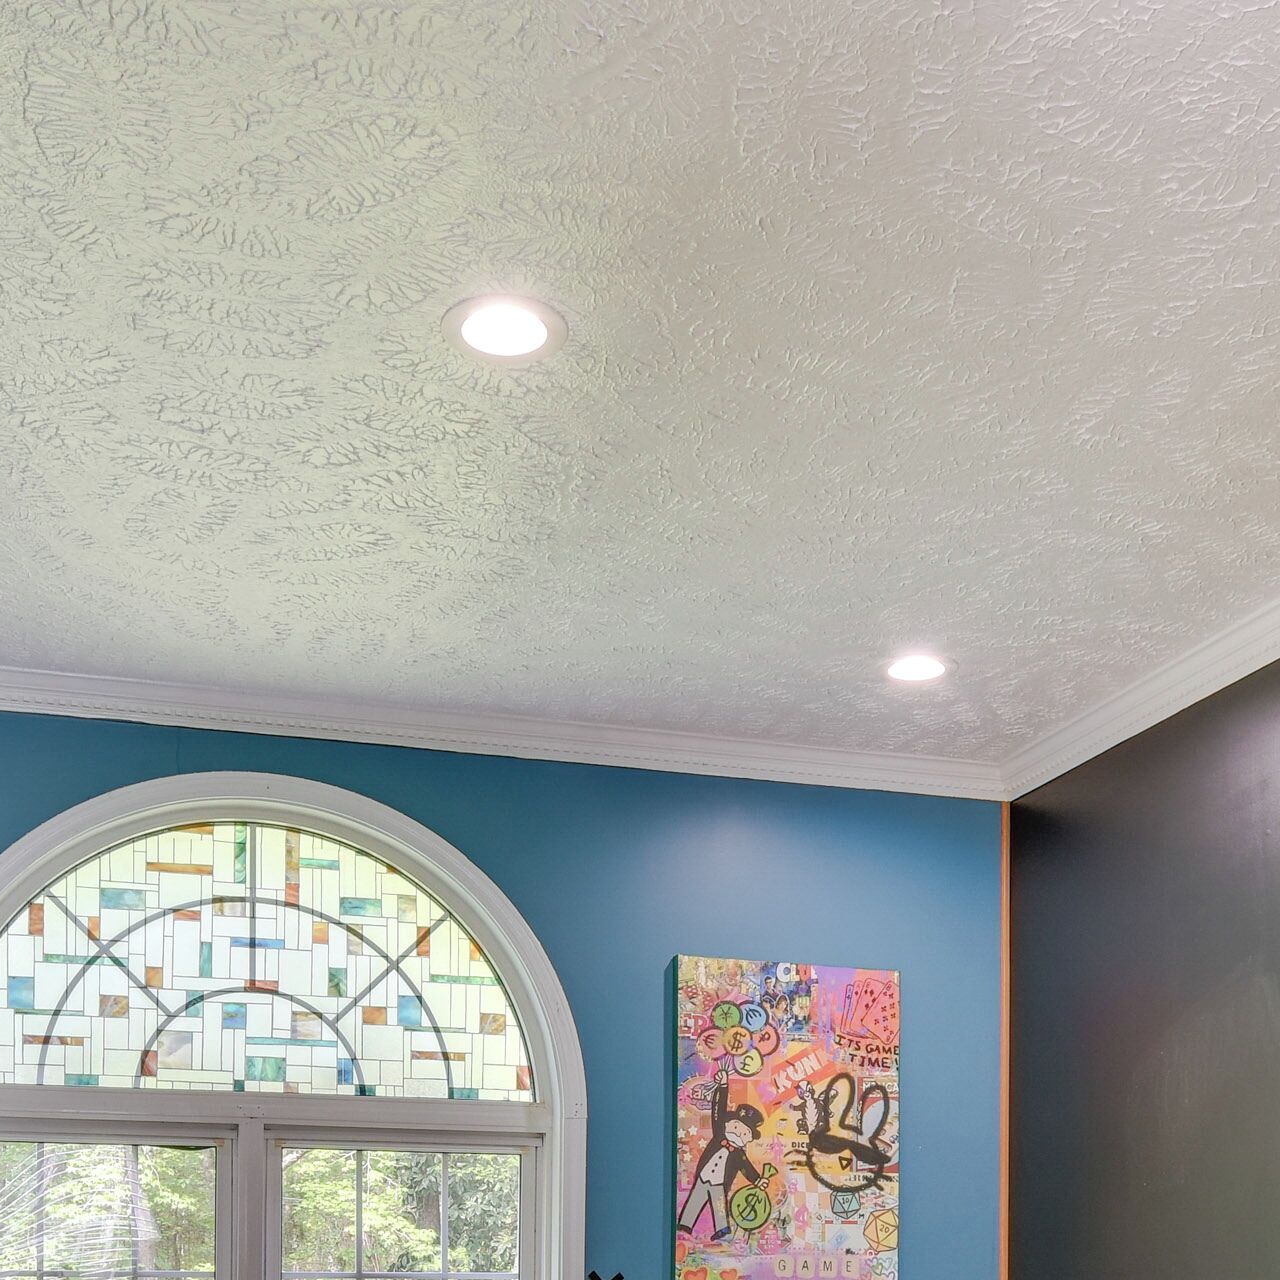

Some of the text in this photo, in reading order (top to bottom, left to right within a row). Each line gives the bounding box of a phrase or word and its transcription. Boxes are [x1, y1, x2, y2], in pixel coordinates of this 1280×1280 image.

[834, 1033, 899, 1056] ITS GAME
[879, 1224, 890, 1234] 20
[778, 1259, 852, 1273] GAME
